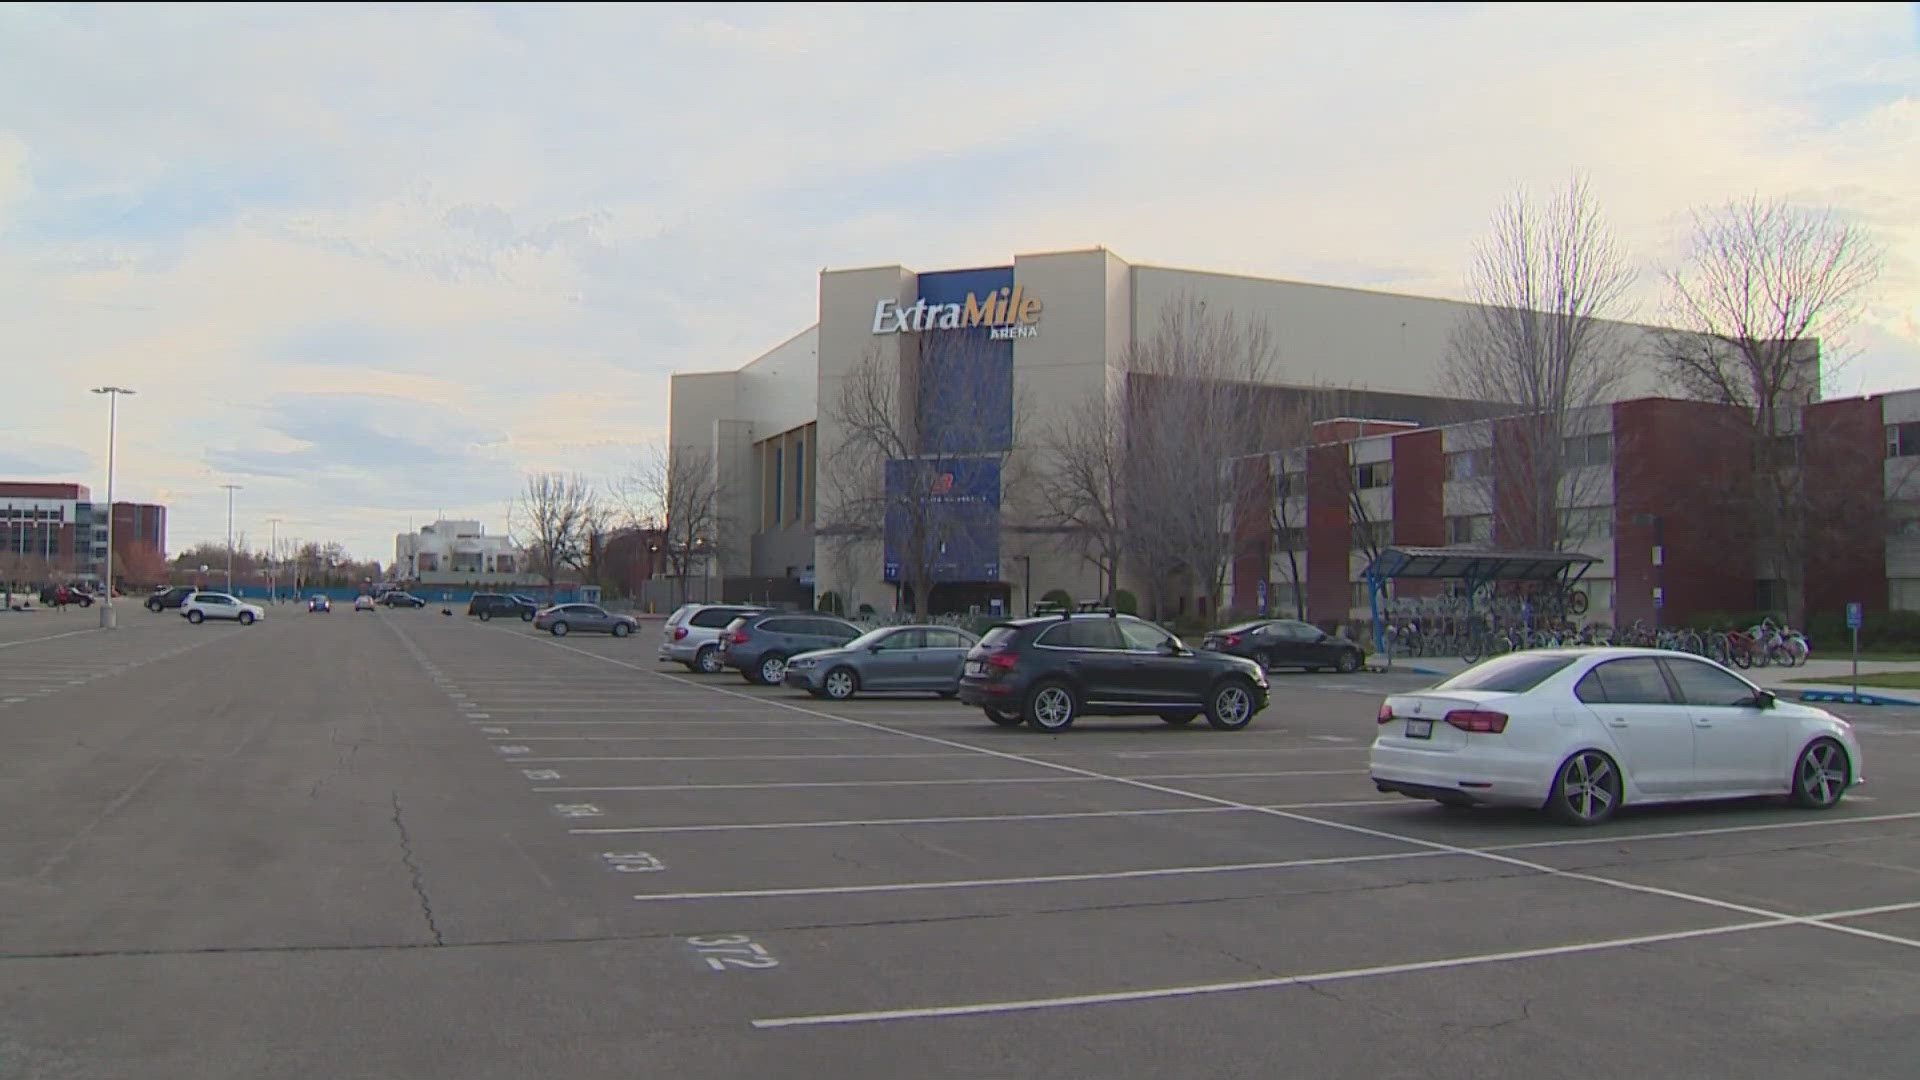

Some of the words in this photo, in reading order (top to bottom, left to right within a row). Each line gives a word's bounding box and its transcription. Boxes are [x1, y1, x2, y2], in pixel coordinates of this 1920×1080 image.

[872, 285, 1042, 335] ExtraMile
[990, 325, 1038, 340] ARENA
[687, 934, 779, 971] 372
